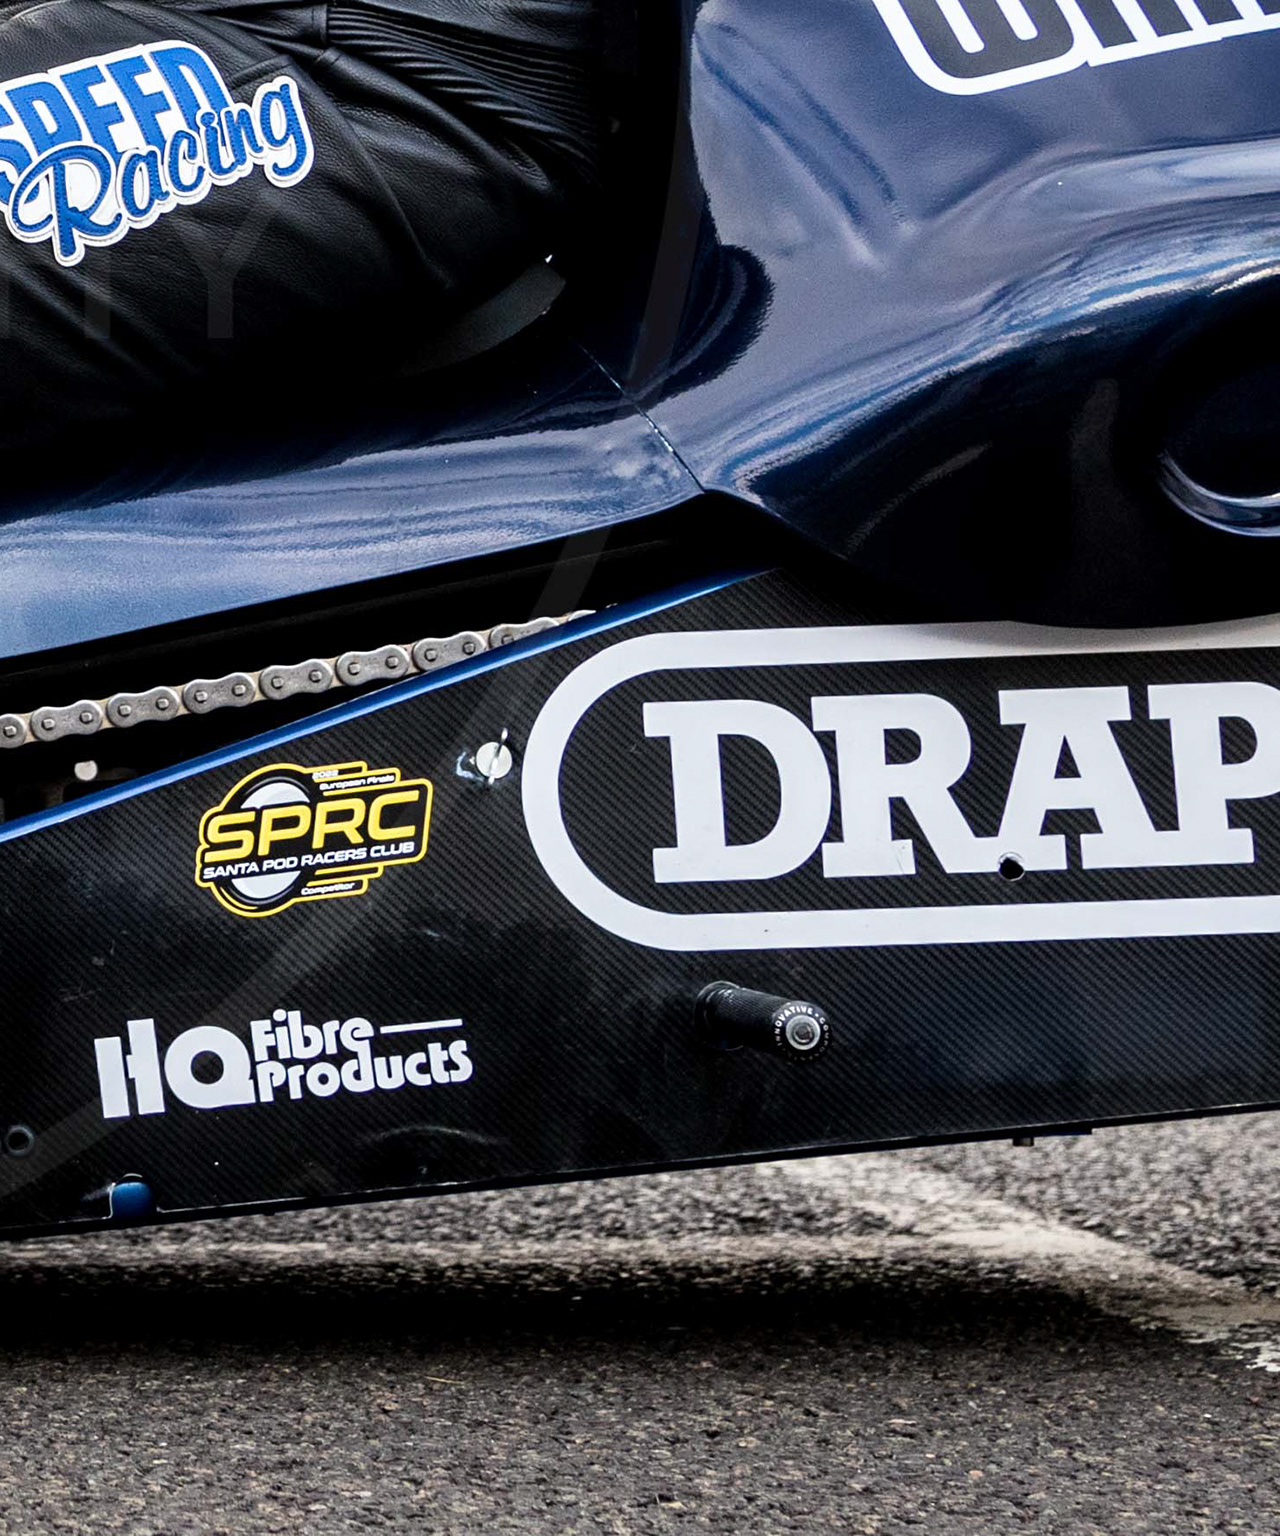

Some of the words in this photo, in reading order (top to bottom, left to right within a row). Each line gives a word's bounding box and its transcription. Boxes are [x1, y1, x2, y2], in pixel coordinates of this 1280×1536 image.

[10, 78, 310, 262] Racing
[204, 790, 420, 863] SPRC
[203, 860, 260, 880] SANTA
[262, 857, 299, 872] POD
[300, 847, 368, 867] RACERS
[369, 841, 415, 858] CLUB
[301, 882, 356, 896] Competitor
[250, 1008, 375, 1062] Fibre
[255, 1039, 474, 1103] Products
